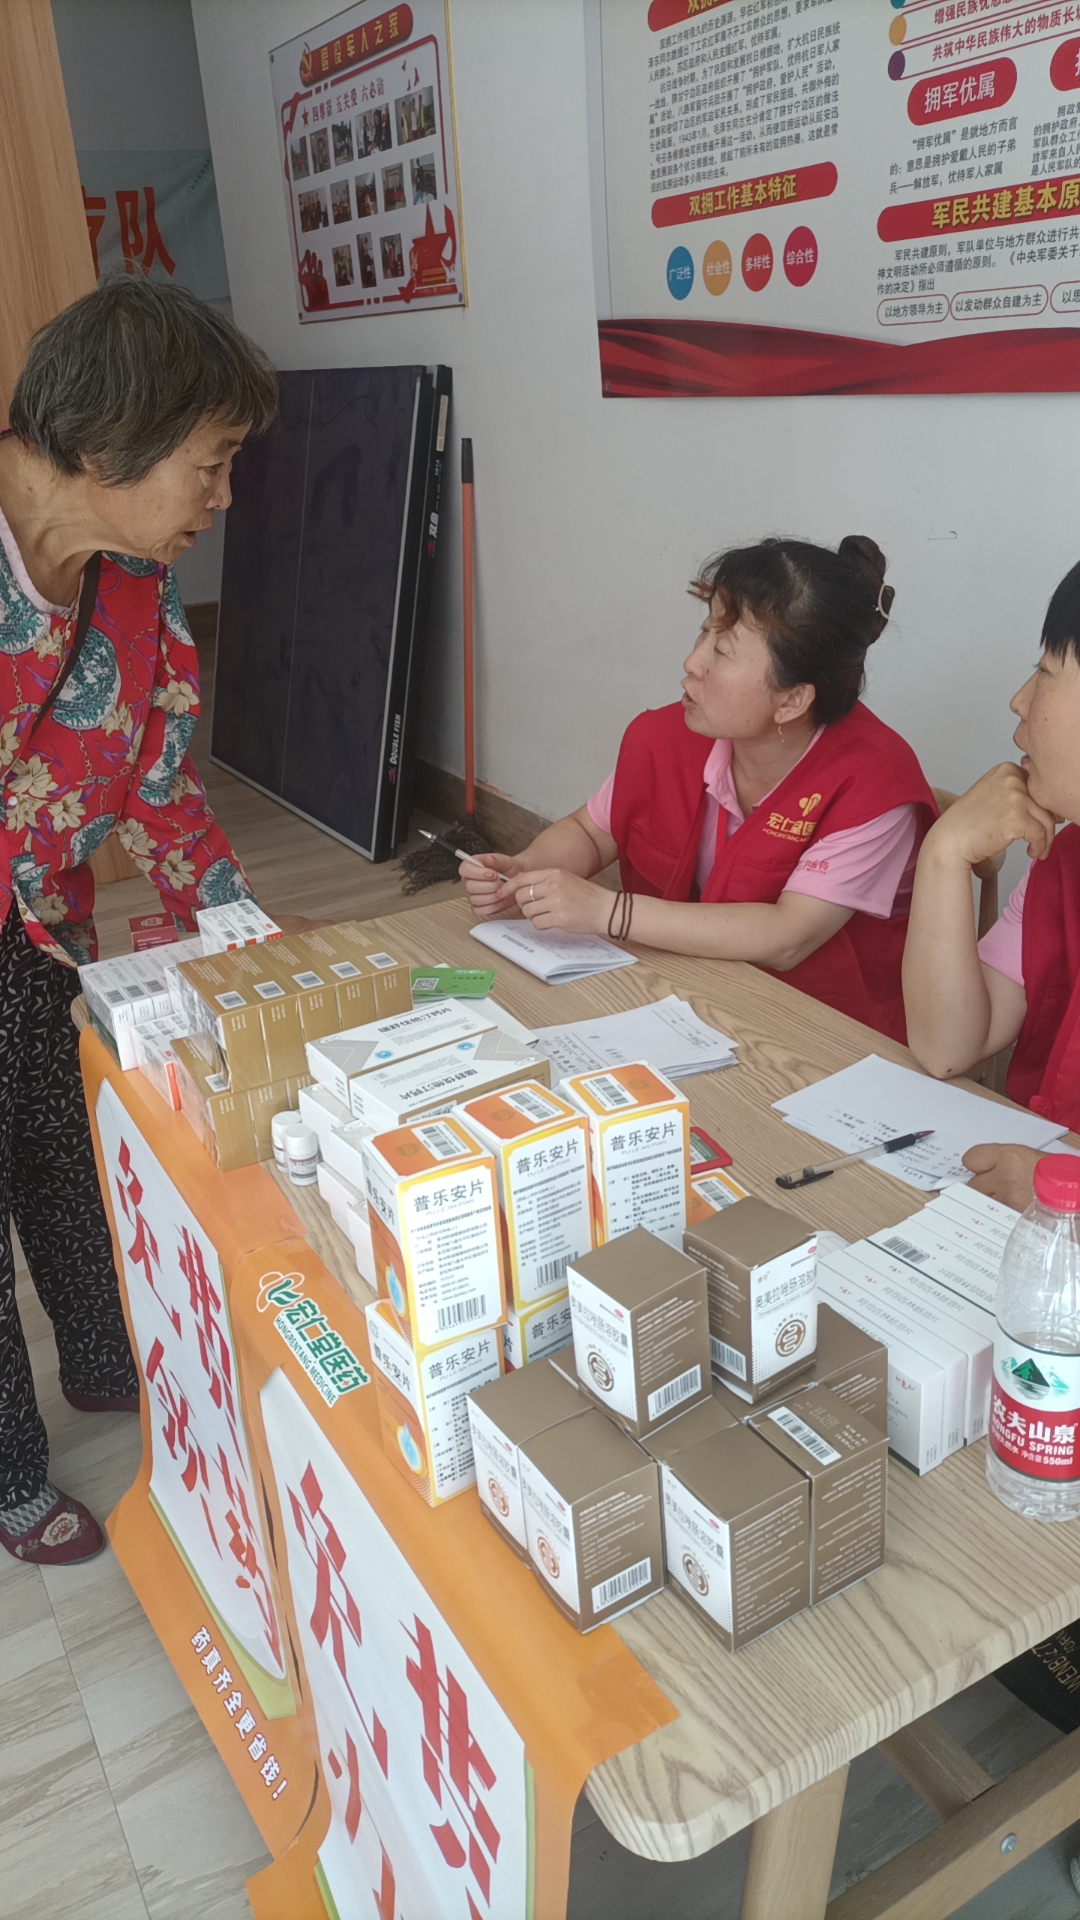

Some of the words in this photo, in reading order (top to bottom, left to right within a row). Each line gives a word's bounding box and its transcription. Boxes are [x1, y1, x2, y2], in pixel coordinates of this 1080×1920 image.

[319, 11, 399, 71] 退役军人之家
[336, 87, 358, 114] 五关爱
[360, 77, 384, 102] 六必访
[923, 70, 996, 114] 拥军优属
[688, 174, 797, 217] 双拥工作基本特征
[931, 178, 1080, 229] 军民共建基本原
[669, 266, 691, 282] 广泛性
[706, 260, 731, 276] 社会性
[745, 254, 771, 272] 多样性
[786, 247, 814, 266] 综合性
[884, 301, 944, 318] 以地方领导为主
[955, 293, 1042, 313] 以发动群众自建为主
[393, 713, 402, 733] FISH
[389, 730, 401, 765] DOUBLE
[610, 1120, 677, 1152] 普乐安片
[515, 1138, 579, 1175] 普乐安片
[366, 1176, 395, 1225] 普乐安片
[413, 1178, 485, 1213] 普乐安片
[275, 1315, 312, 1369] HONGRENTANG
[308, 1366, 337, 1405] MEDICINE
[283, 1299, 369, 1393] 宏仁堂医药
[428, 1339, 491, 1379] 普乐安片
[372, 1342, 412, 1393] 普乐安片
[992, 1413, 1026, 1447] NONGFU
[1028, 1441, 1074, 1456] SPRING
[993, 1394, 1076, 1445] 农夫山泉
[190, 1624, 288, 1802] 药真齐全更省钱!
